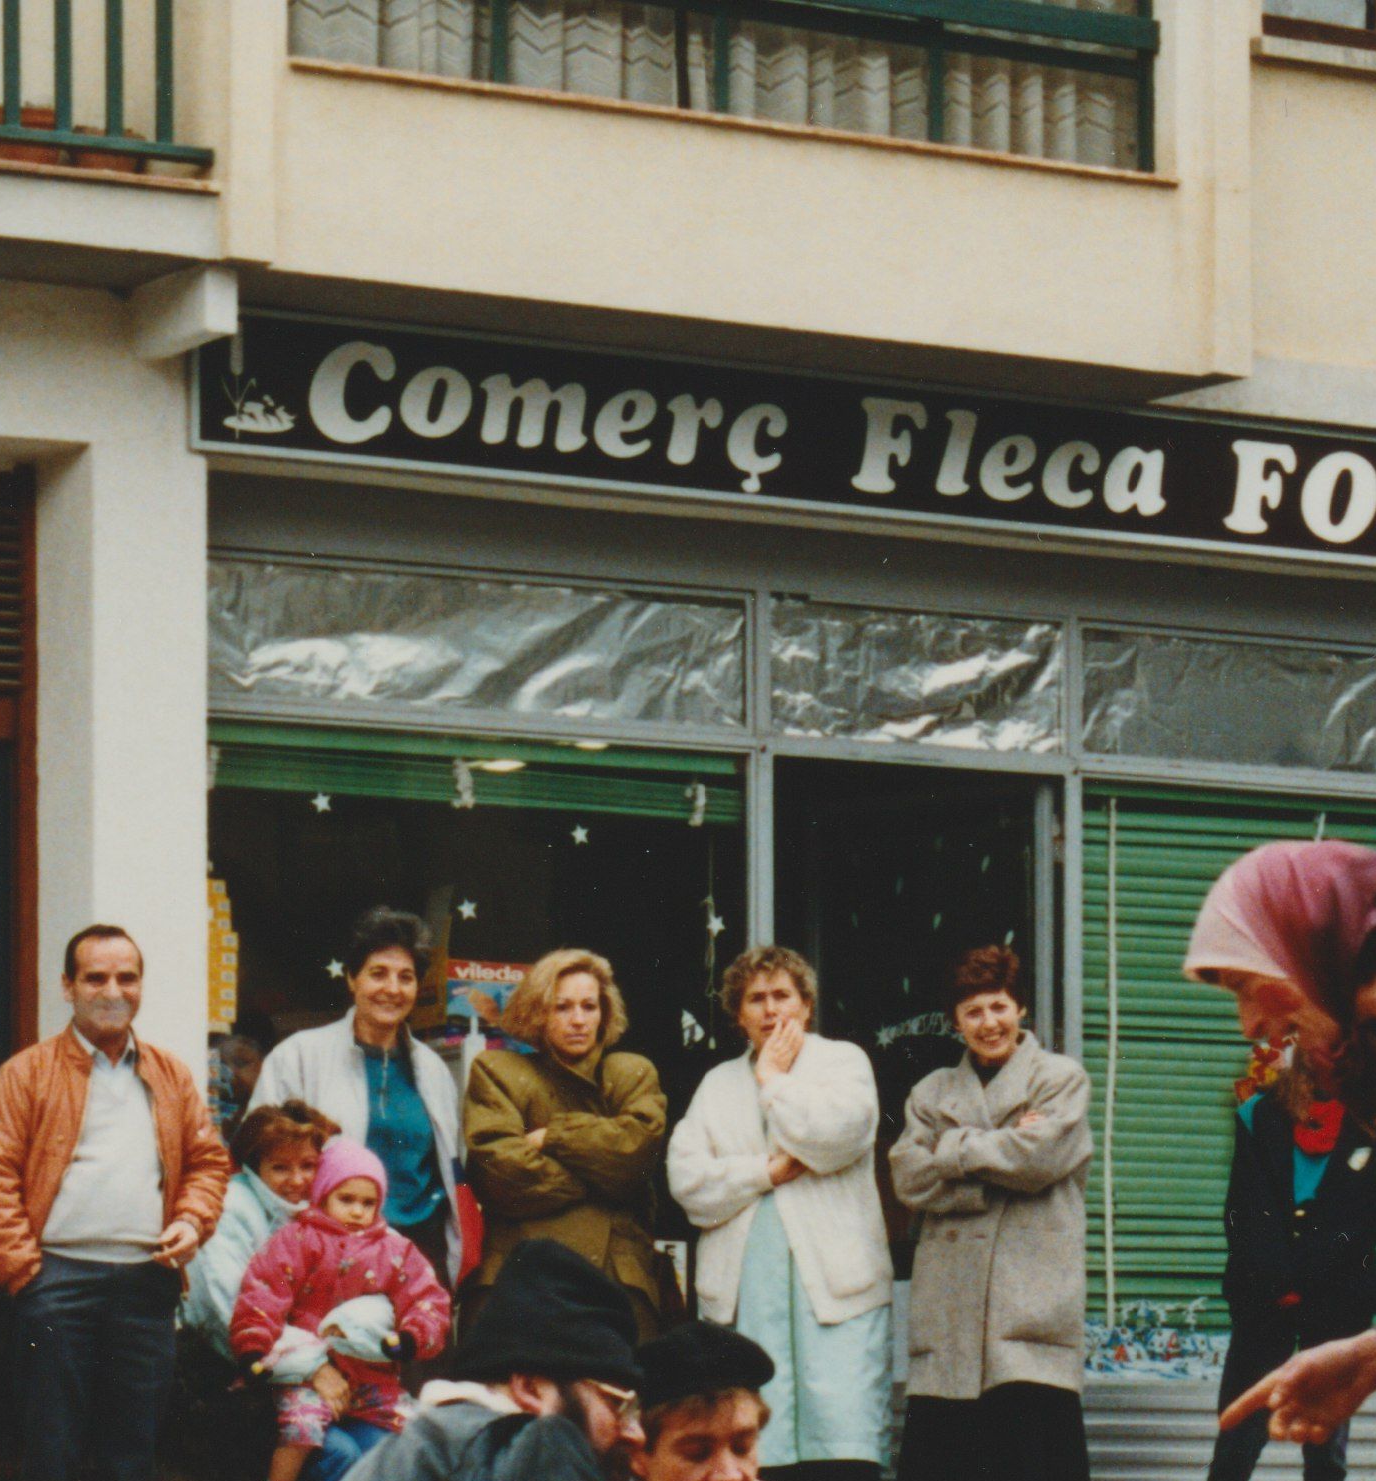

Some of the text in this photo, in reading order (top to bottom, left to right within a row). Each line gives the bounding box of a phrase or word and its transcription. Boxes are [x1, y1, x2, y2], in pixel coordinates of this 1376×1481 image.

[309, 341, 788, 493] Comerç
[850, 397, 1167, 517] Fleca
[454, 961, 525, 981] vileda
